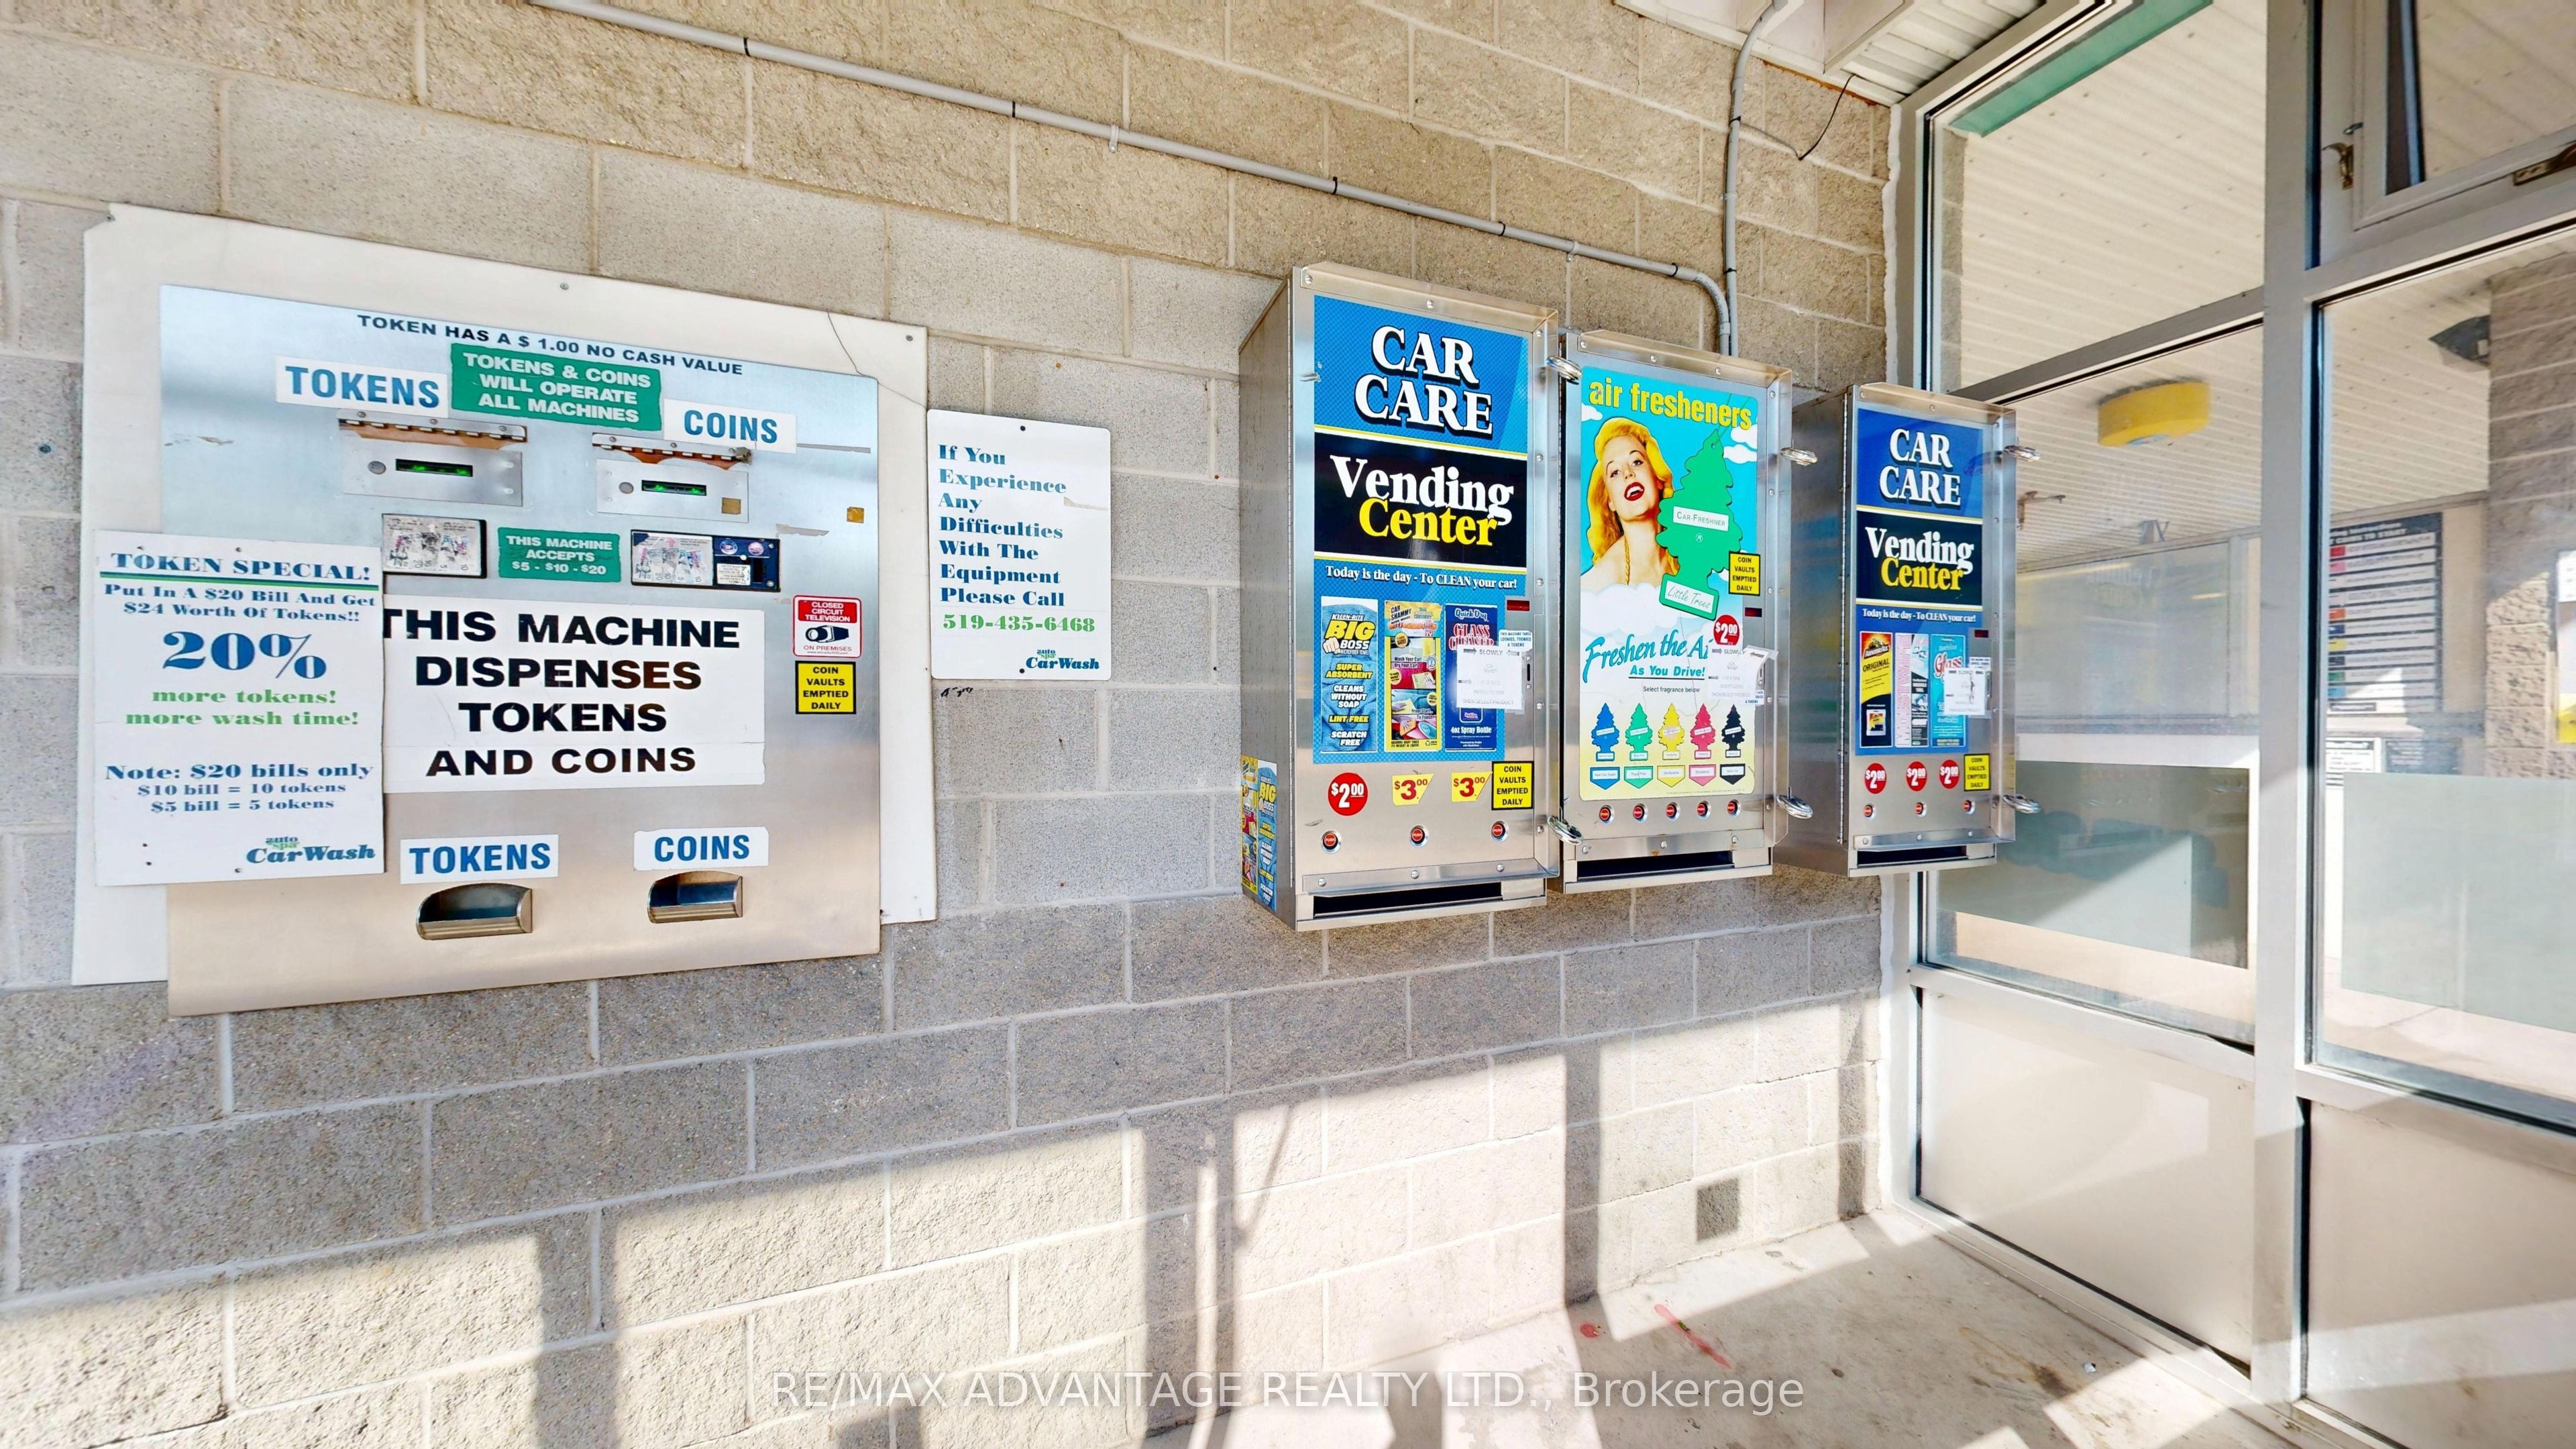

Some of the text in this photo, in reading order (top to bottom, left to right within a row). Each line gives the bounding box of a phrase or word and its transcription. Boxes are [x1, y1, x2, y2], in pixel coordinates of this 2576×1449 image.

[358, 315, 743, 375] TOKEN HAS A $ 1.00 NO CASH VALUE
[1371, 325, 1480, 386] CAR
[463, 352, 651, 388] TOKENS & COINS
[285, 366, 440, 409] TOKENS
[479, 373, 638, 405] WILL OPERATE
[478, 393, 639, 423] ALL MACHINES
[1354, 374, 1493, 438] CARE
[1589, 377, 1752, 431] air fresheners
[684, 410, 778, 444] COINS
[938, 443, 1007, 466] If You
[1889, 427, 1953, 469] CAR
[938, 468, 1067, 494] Experience
[1330, 454, 1515, 526] Vending
[1879, 465, 1962, 507] CARE
[938, 492, 983, 514] Any
[939, 516, 1064, 539] Difficulties
[1358, 496, 1499, 547] Center
[506, 535, 613, 551] THIS MACHINE
[938, 539, 1039, 561] With The
[1865, 527, 1974, 575] Vending
[526, 549, 596, 562] ACCEPTS
[111, 553, 371, 581] TOKEN SPECIAL!
[512, 561, 607, 575] $5 $10 $20
[940, 563, 1062, 586] Equipment
[1880, 557, 1964, 591] Center
[1325, 566, 1518, 590] Today is the day To CLEAN your car!
[1732, 575, 1757, 583] EMPTIED
[104, 583, 376, 607] Put In A $20 Bill And Get
[811, 601, 845, 609] CLOSED
[939, 586, 1065, 607] Please Call
[123, 602, 360, 623] $24 Worth Of Tokens!!
[805, 614, 851, 623] TELEVISION
[811, 608, 845, 616] CIRCUIT
[1391, 605, 1401, 614] CAR
[1391, 608, 1411, 621] SHAMMY
[1454, 608, 1474, 620] Quick
[1862, 608, 1977, 623] Today the day CLEAN your car!
[383, 608, 740, 649] THIS MACHINE
[943, 613, 1096, 633] 519-435-6468
[1324, 620, 1376, 641] BIG
[1453, 623, 1491, 639] GLASS
[1340, 639, 1370, 650] BOSS
[162, 631, 327, 680] 20%
[1025, 656, 1100, 670] CarWash
[1582, 629, 1688, 684] Freshen the
[1862, 658, 1890, 672] ORIGINAL
[415, 655, 702, 691] DISPENSES
[812, 666, 839, 674] COIN
[1326, 671, 1373, 679] ABSORBENT
[1629, 665, 1706, 678] As You Drive!
[806, 678, 846, 686] VAULTS
[1660, 686, 1684, 694] fragrance
[152, 689, 337, 704] more tokens!
[802, 690, 849, 698] EMPTIED
[1338, 700, 1360, 708] SOAP
[811, 702, 842, 710] DAILY
[126, 711, 359, 726] more wash time!
[458, 702, 667, 733] TOKENS
[1460, 726, 1493, 735] Spray Bottle
[105, 763, 374, 780] Note: $20 bills only
[425, 747, 696, 777] AND COINS
[138, 782, 347, 797] $10 bill 10 tokens
[1259, 782, 1277, 803] BIG
[150, 798, 335, 814] $5 bill 5 tokens
[246, 844, 376, 865] CarWash
[654, 834, 751, 862] COINS
[409, 843, 551, 875] TOKENS
